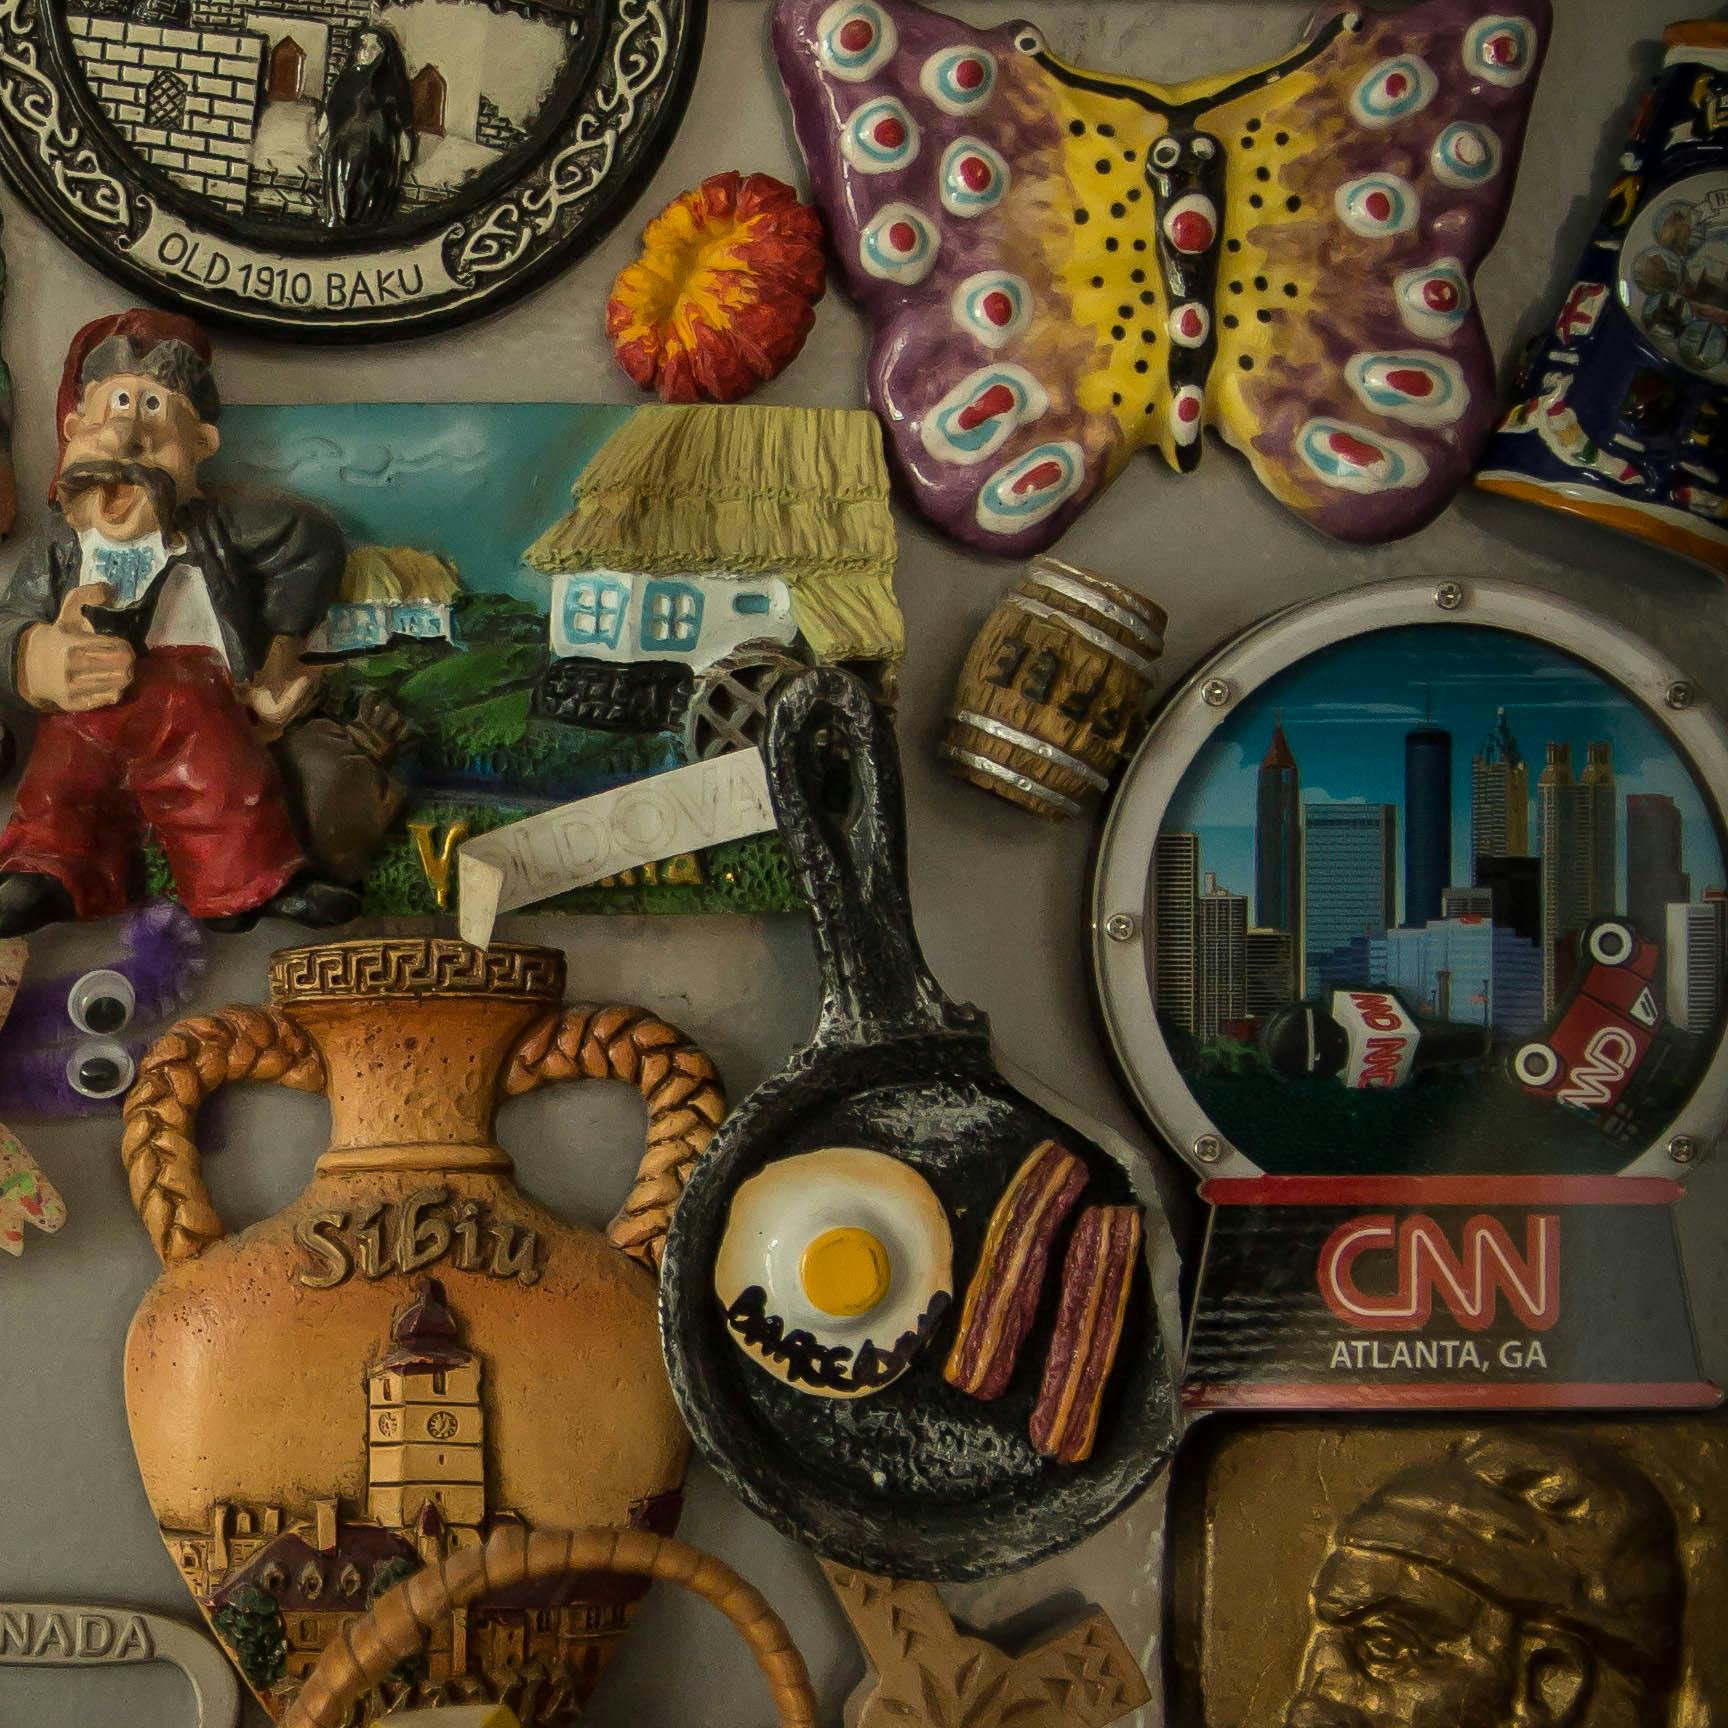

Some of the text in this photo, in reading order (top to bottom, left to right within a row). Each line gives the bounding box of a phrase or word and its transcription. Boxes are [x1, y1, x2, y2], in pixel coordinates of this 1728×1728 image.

[157, 231, 424, 309] OLD 1910 BAKU
[294, 1185, 542, 1289] Sibiu
[1316, 1213, 1561, 1332] CNN
[1329, 1340, 1548, 1373] ATLANTA, GA
